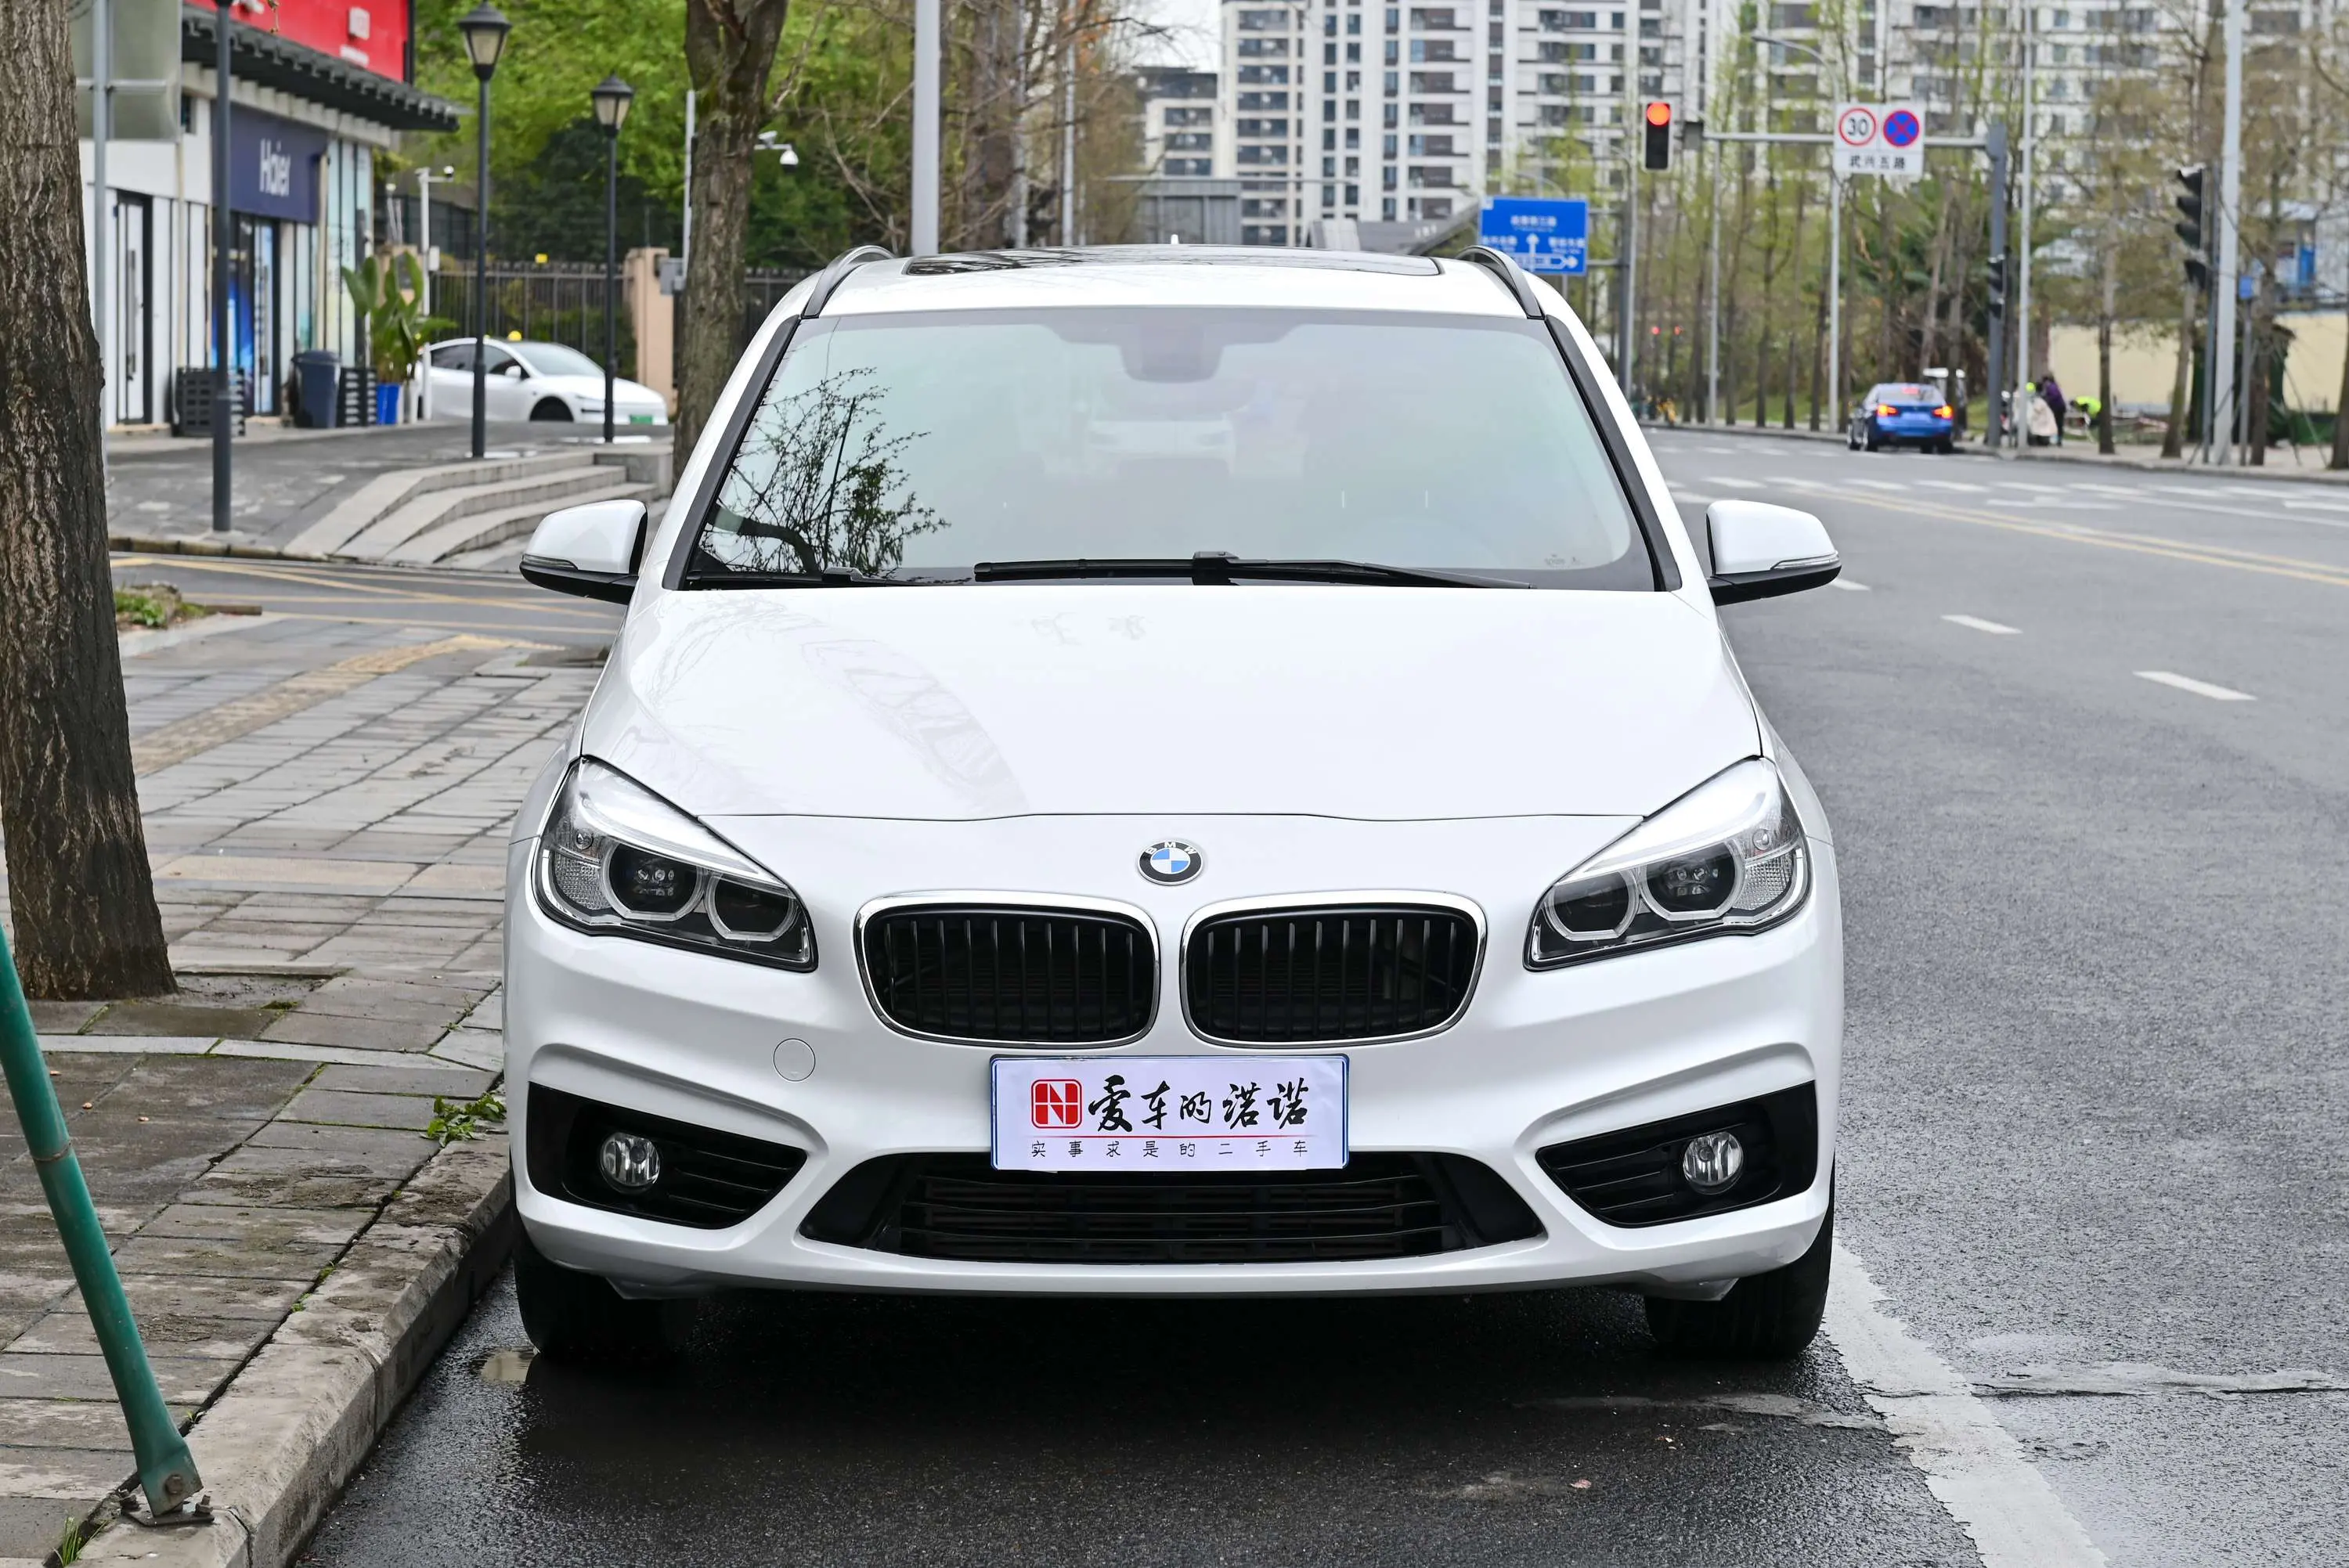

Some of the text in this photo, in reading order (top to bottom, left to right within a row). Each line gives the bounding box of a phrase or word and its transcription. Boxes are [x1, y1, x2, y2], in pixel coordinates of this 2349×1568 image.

[1848, 117, 1867, 135] 30
[259, 138, 290, 196] Haier
[1146, 842, 1197, 855] BMW
[1031, 1140, 1308, 1158] 实事求是的二手车
